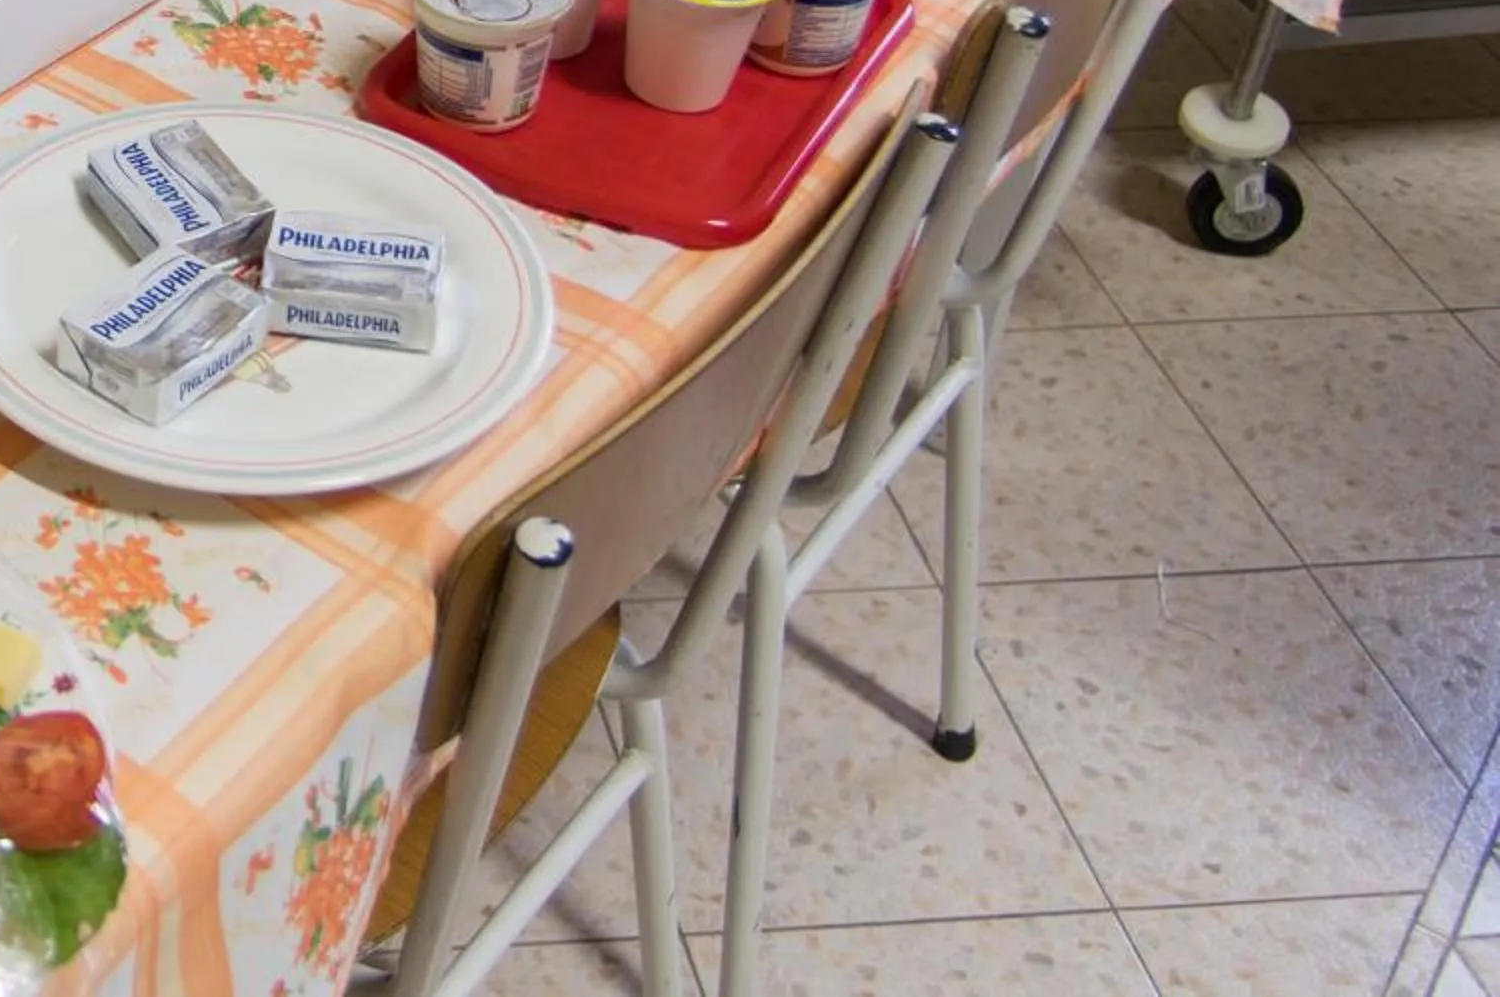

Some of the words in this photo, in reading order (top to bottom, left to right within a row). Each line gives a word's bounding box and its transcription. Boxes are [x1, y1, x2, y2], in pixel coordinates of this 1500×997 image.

[122, 142, 211, 232] PHILADELPHIA
[277, 226, 431, 262] PHILADELPHIA
[90, 259, 206, 341] PHILADELPHIA
[286, 304, 401, 335] PHILADELPHIA
[178, 334, 254, 402] PHILADELPHIA
